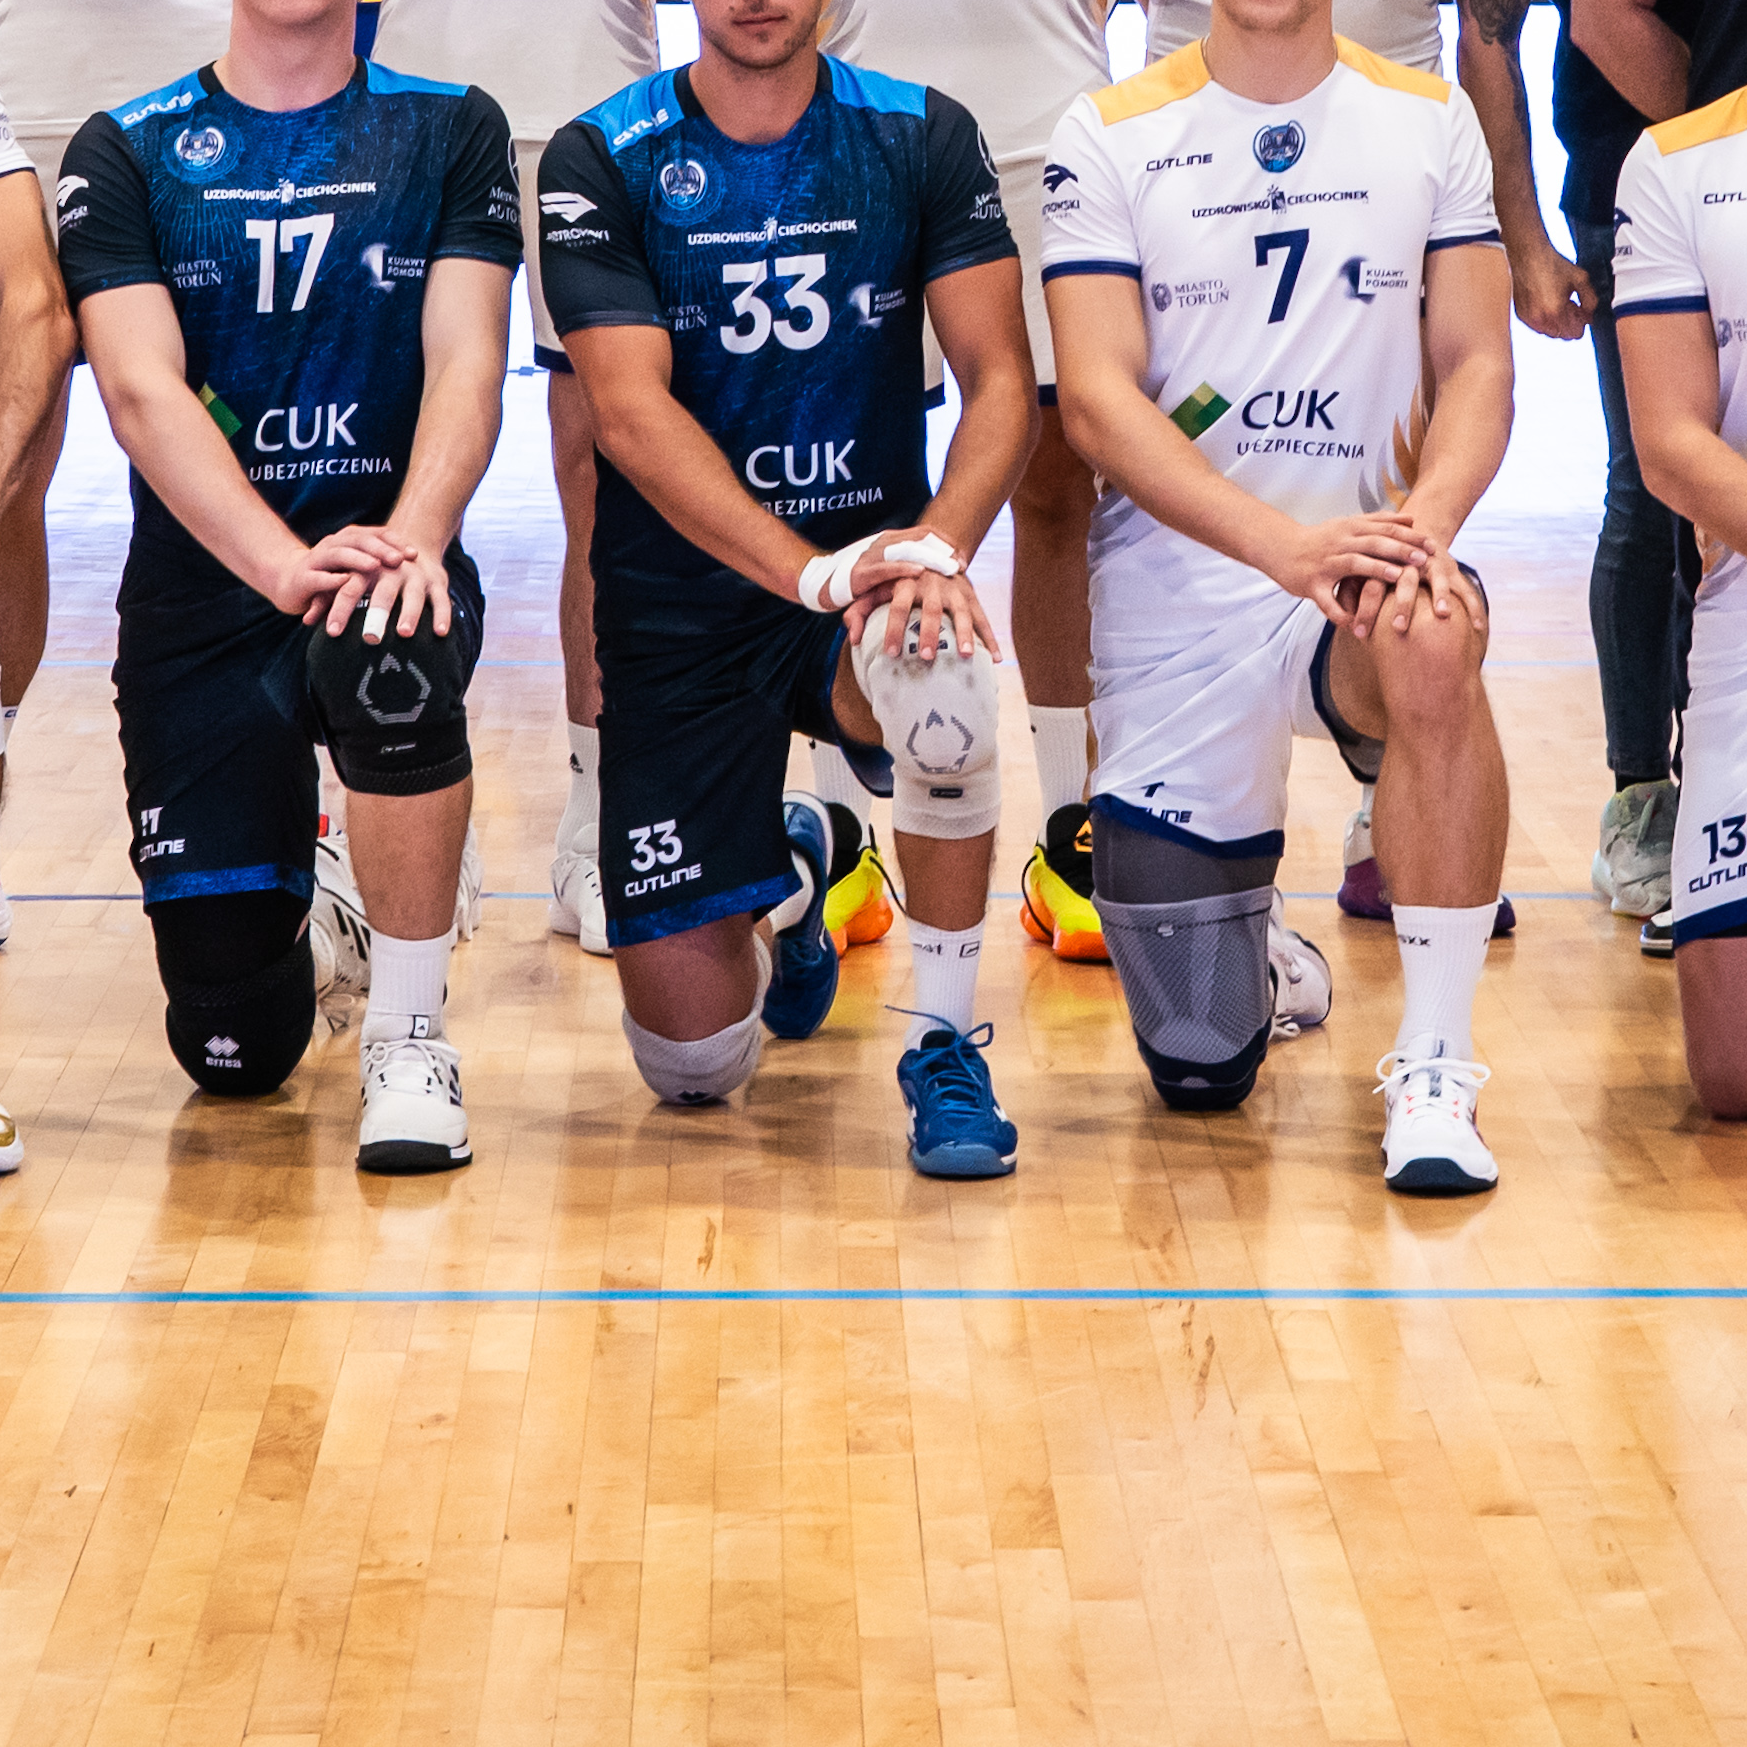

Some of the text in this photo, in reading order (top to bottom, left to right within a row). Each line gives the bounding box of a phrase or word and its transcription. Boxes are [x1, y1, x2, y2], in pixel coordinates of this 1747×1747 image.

[1145, 152, 1214, 173] CUTLINE
[203, 181, 378, 204] UZDROWISKO CIECHOCINEK
[1192, 189, 1369, 220] UZDROWISKO CIECHOCINEK
[687, 218, 858, 247] UZDROWISKO CIECHOCINEK
[244, 213, 335, 314] 17
[386, 256, 427, 268] KUJAWY
[1254, 229, 1310, 325] 7
[719, 253, 830, 354] 33
[1174, 279, 1224, 295] MIASTO
[254, 402, 359, 454] CUK
[1241, 390, 1340, 432] CUK
[249, 456, 394, 483] UBEZPIECZENIA
[745, 438, 856, 490] CUK
[628, 819, 684, 873] 33
[1701, 813, 1747, 866] 13
[623, 862, 703, 898] CUTLINE
